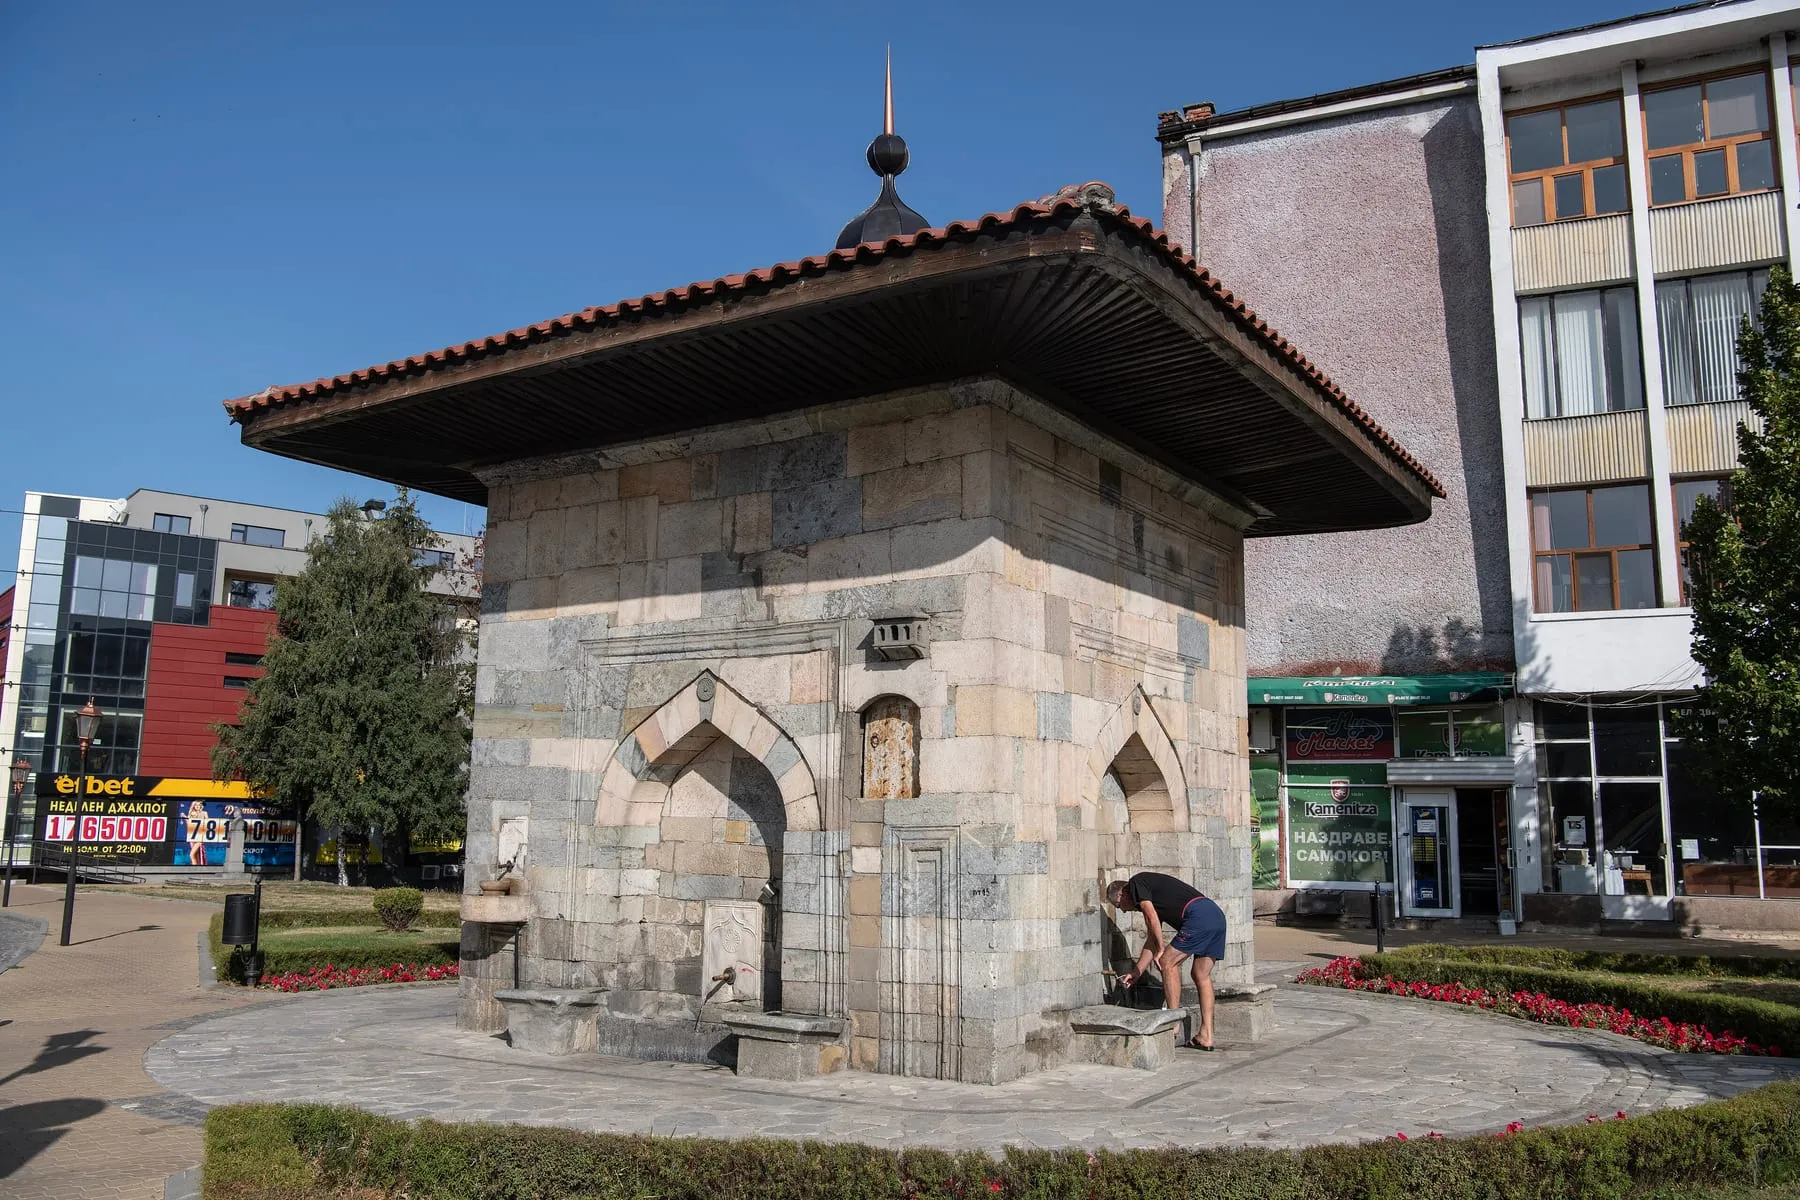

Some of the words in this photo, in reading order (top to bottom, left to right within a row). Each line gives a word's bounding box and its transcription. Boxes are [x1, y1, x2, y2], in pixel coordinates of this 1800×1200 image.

[1333, 694, 1368, 703] Kamenitza
[1296, 732, 1375, 756] Market
[50, 801, 104, 813] НЕДЛЕН
[107, 803, 167, 814] ДЖАКПОТ
[1304, 802, 1378, 817] Kamenitza
[48, 817, 165, 841] 1765000
[1294, 831, 1392, 847] НАЗДРАВЕ,
[1296, 850, 1388, 862] САМОКОВ!
